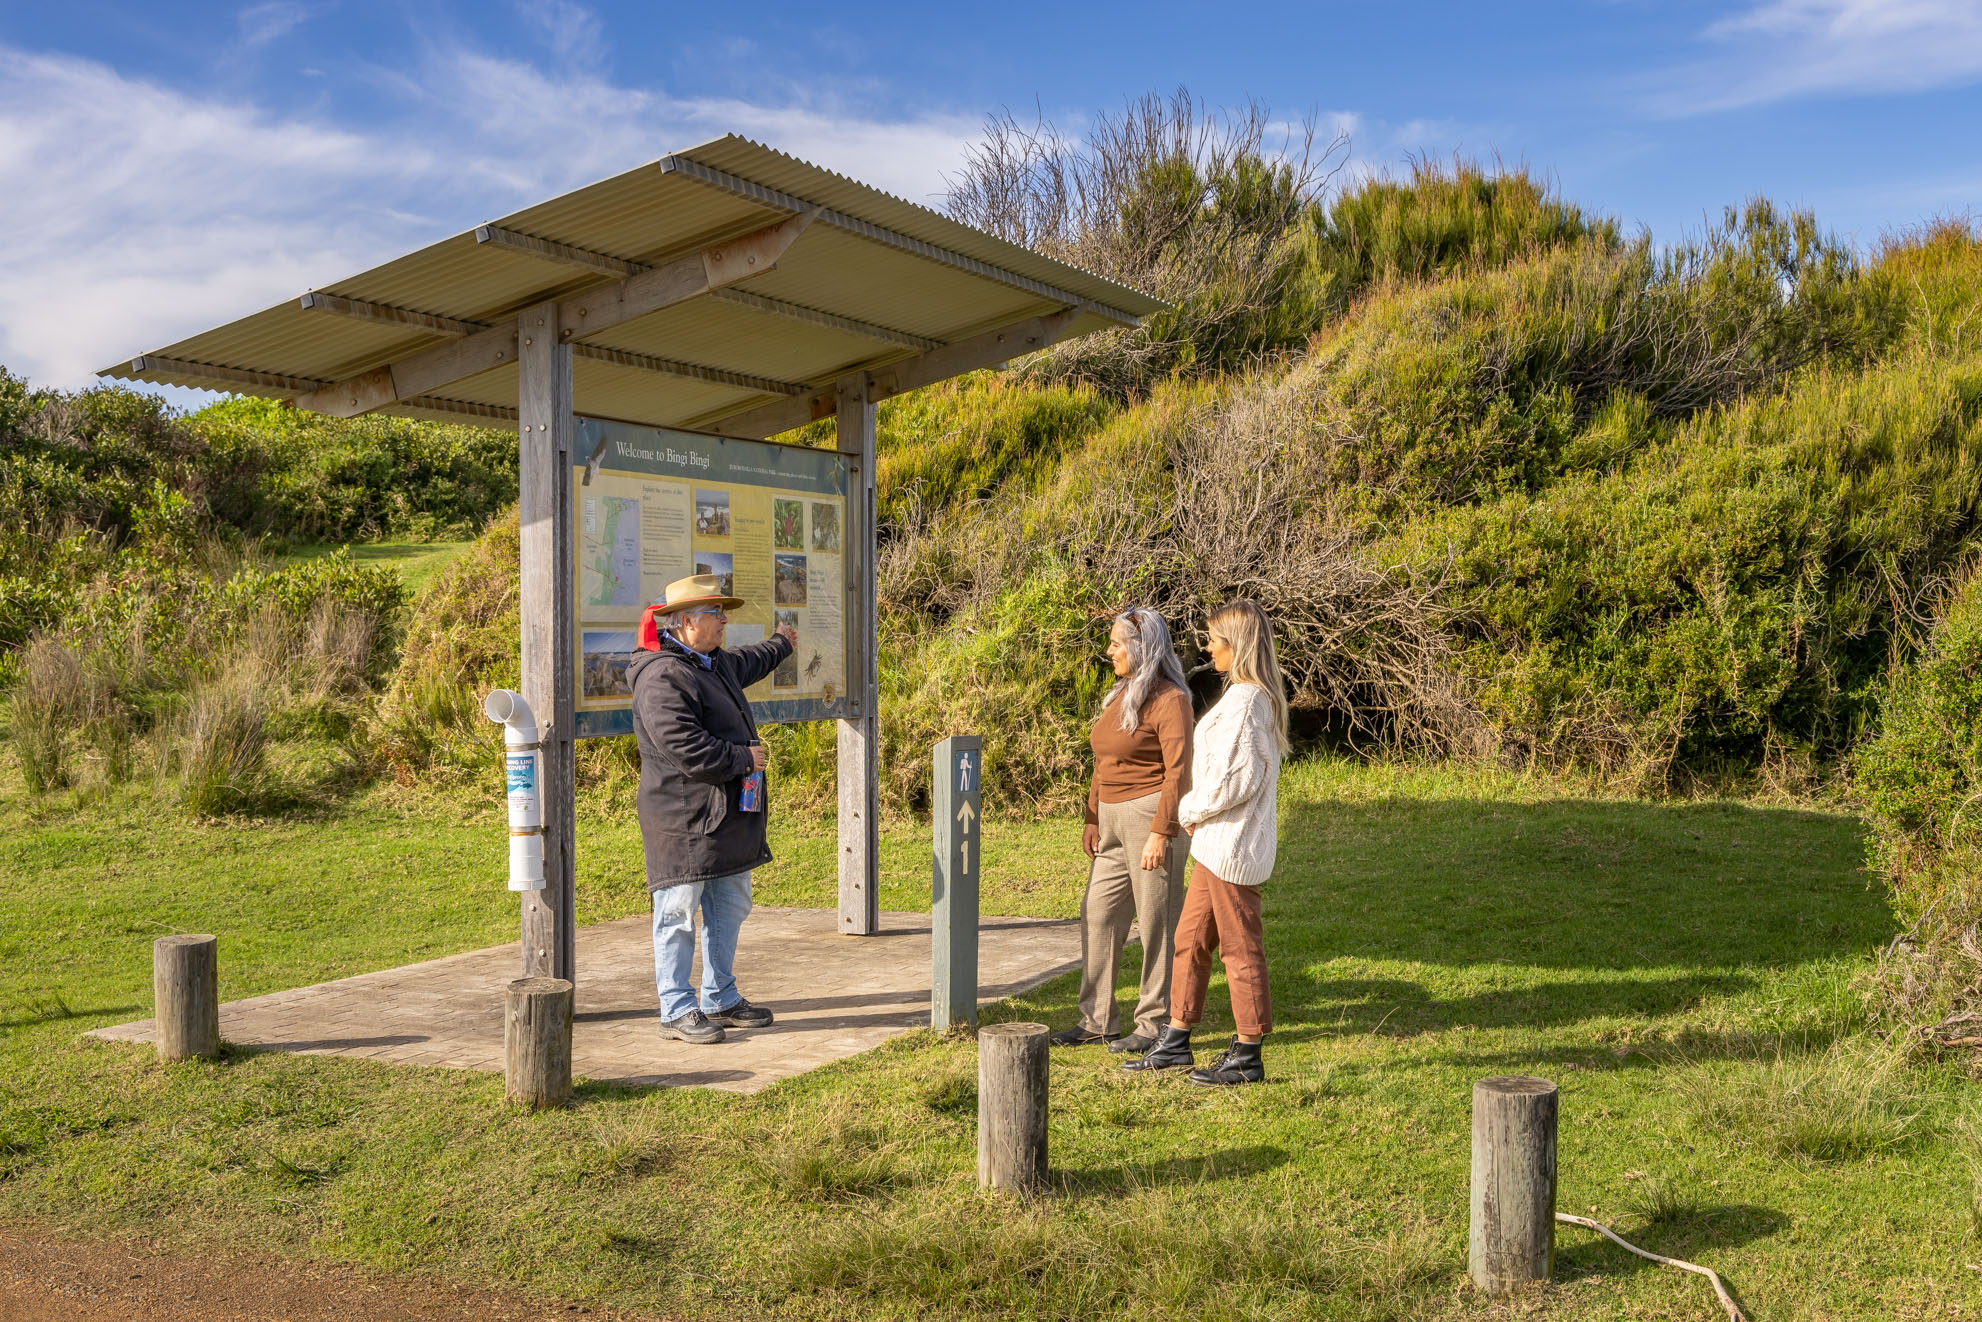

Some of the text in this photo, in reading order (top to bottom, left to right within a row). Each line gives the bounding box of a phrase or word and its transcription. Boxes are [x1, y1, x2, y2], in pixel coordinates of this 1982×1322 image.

[616, 441, 710, 470] Welcome to Bingi Bingi
[961, 840, 969, 875] 1
